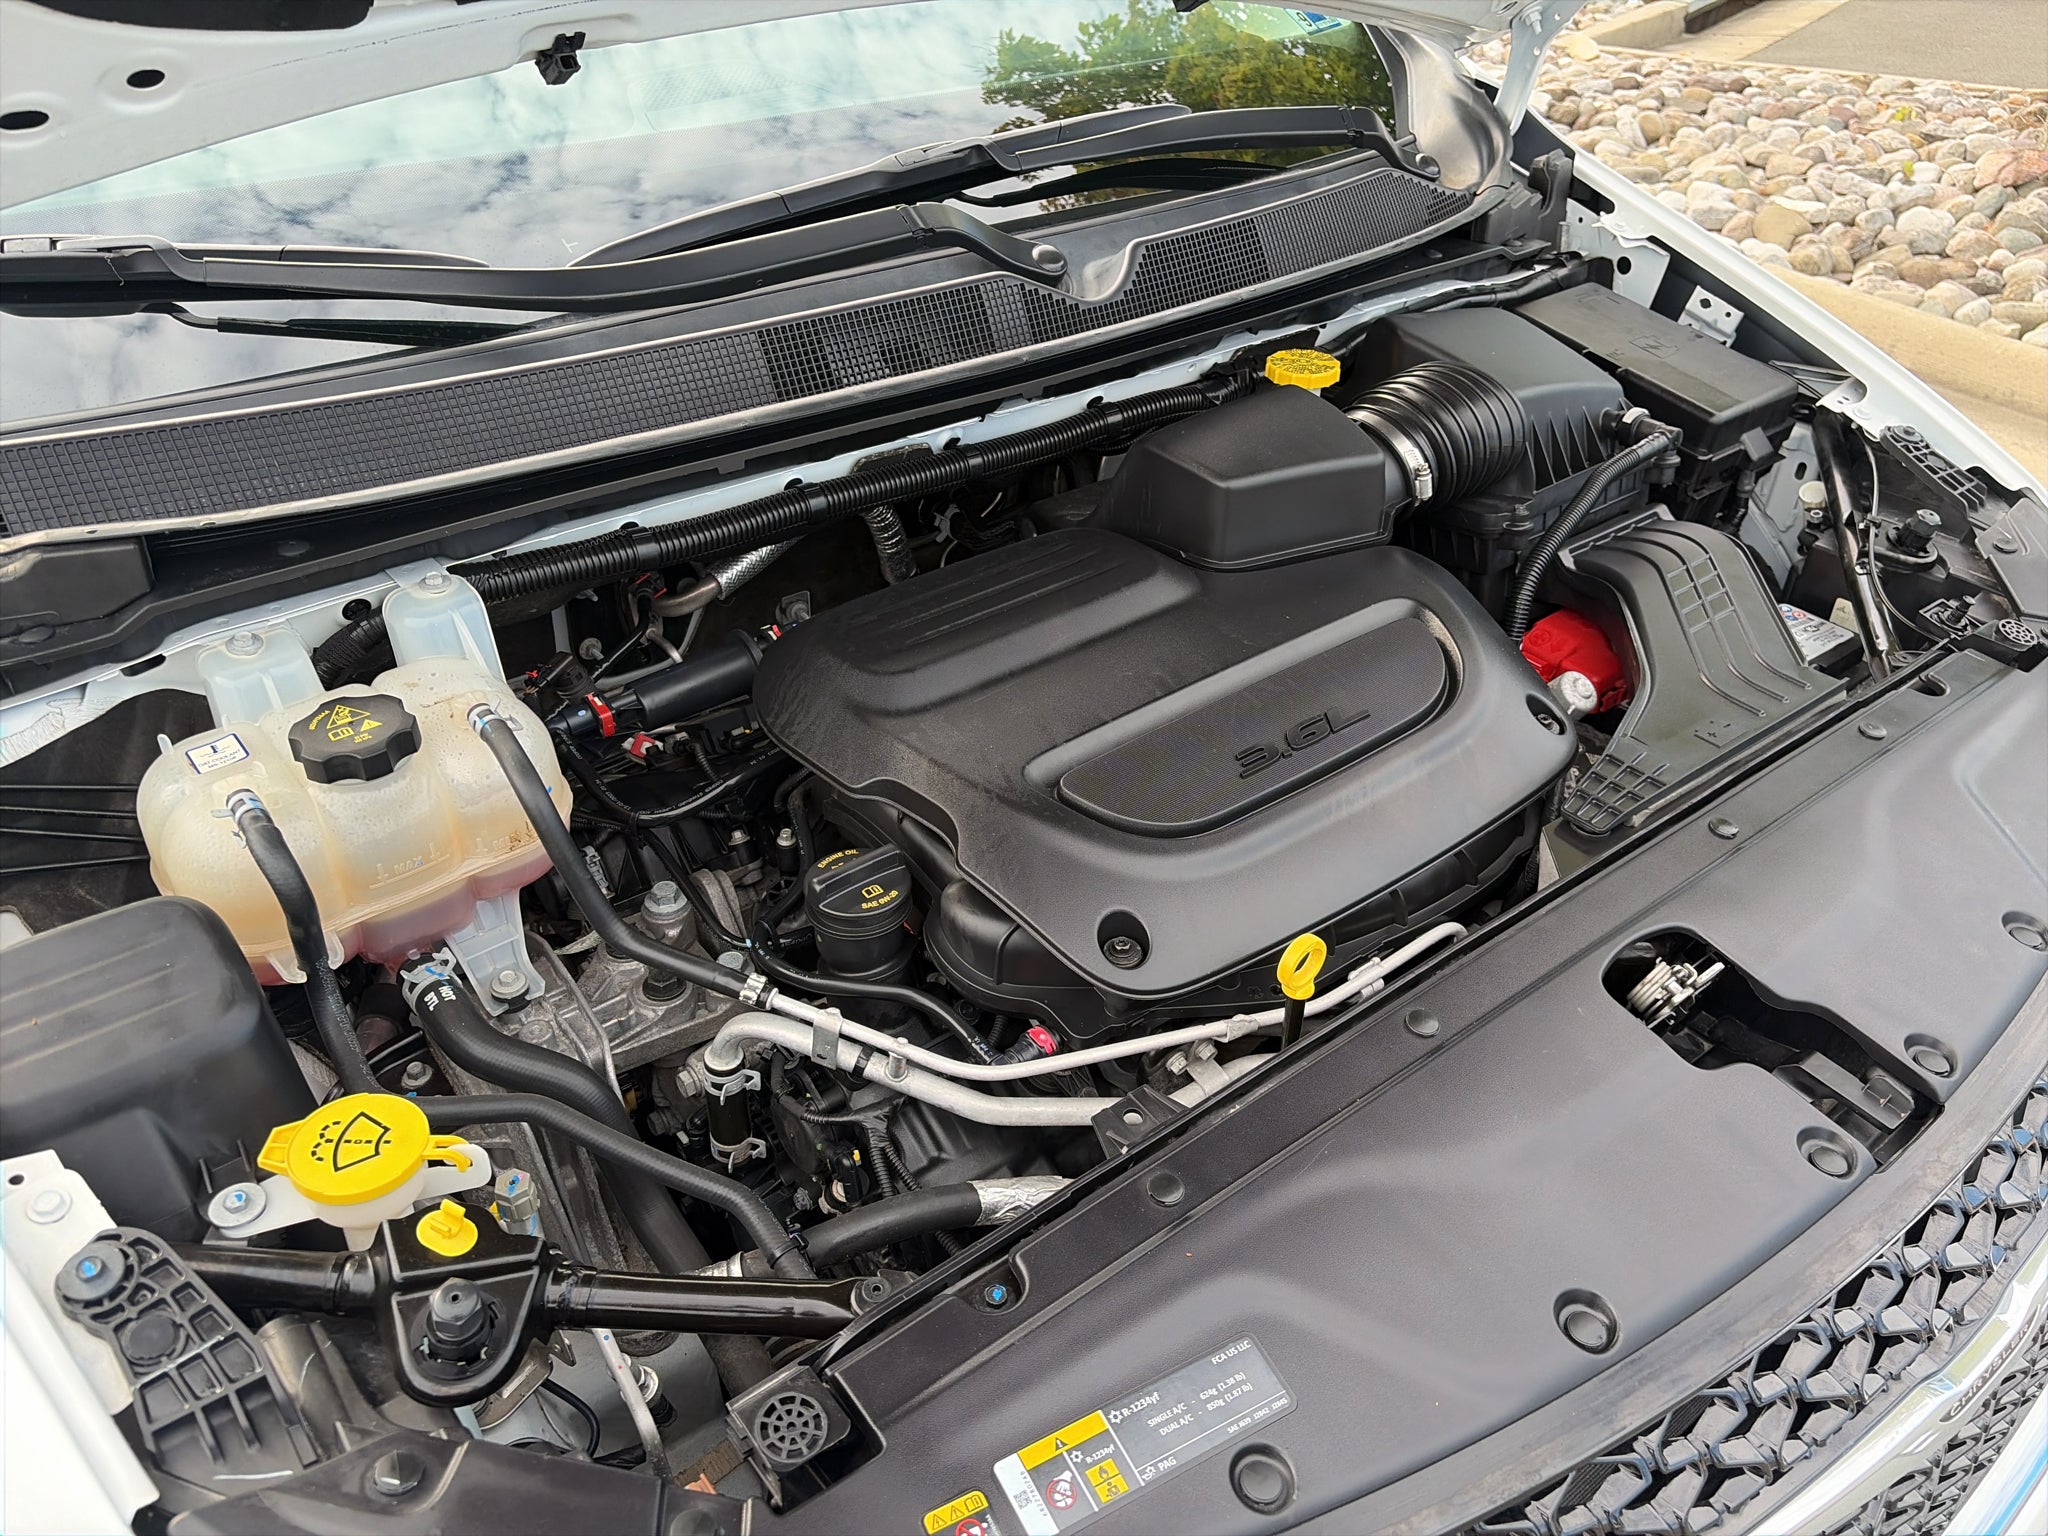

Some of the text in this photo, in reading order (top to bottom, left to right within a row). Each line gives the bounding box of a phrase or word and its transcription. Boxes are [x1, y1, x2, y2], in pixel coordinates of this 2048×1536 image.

[1235, 706, 1371, 779] 3.6L
[817, 851, 844, 868] ENGINE
[861, 890, 899, 909] SAE 0W-20
[438, 985, 457, 1001] HOT
[1211, 1340, 1251, 1365] FCA US LLC
[1950, 1324, 2029, 1416] CHRYSLER
[1121, 1391, 1161, 1417] R-1234yf
[1147, 1410, 1174, 1427] SINGLE
[1173, 1402, 1188, 1415] A/C
[1200, 1388, 1218, 1401] 624g
[1217, 1376, 1236, 1392] (1.38
[1235, 1372, 1246, 1384] lb)
[1159, 1422, 1180, 1436] DUAL
[1180, 1413, 1195, 1426] A/C
[1206, 1399, 1226, 1412] 850g
[1225, 1387, 1243, 1403] (1.87
[1242, 1382, 1253, 1394] lb)
[1226, 1423, 1240, 1434] SAE
[1085, 1443, 1115, 1464] R-1234yf
[1158, 1456, 1177, 1471] PAG
